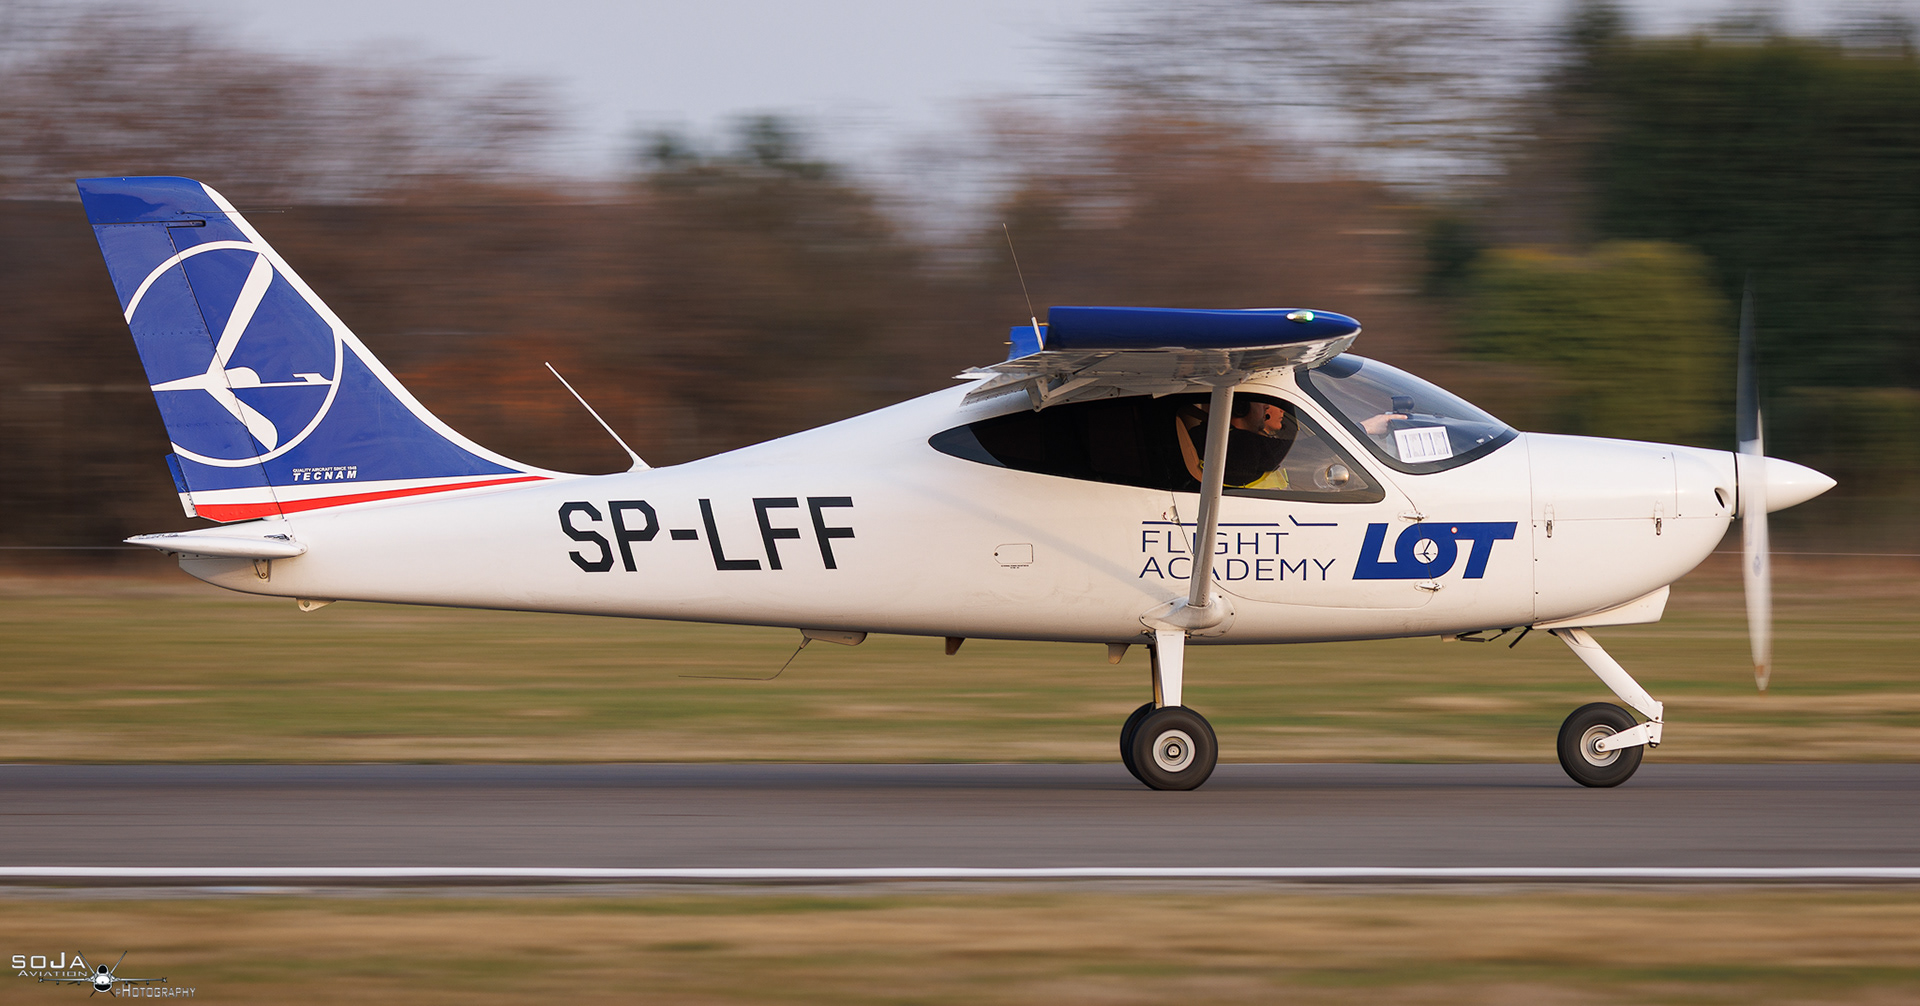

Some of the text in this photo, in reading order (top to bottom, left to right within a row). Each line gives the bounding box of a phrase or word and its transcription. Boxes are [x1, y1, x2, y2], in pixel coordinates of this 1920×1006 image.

[292, 470, 357, 481] TECNAM
[557, 496, 856, 573] SP-LFF
[1351, 521, 1518, 581] LOT
[1138, 556, 1336, 581] ACDEMY
